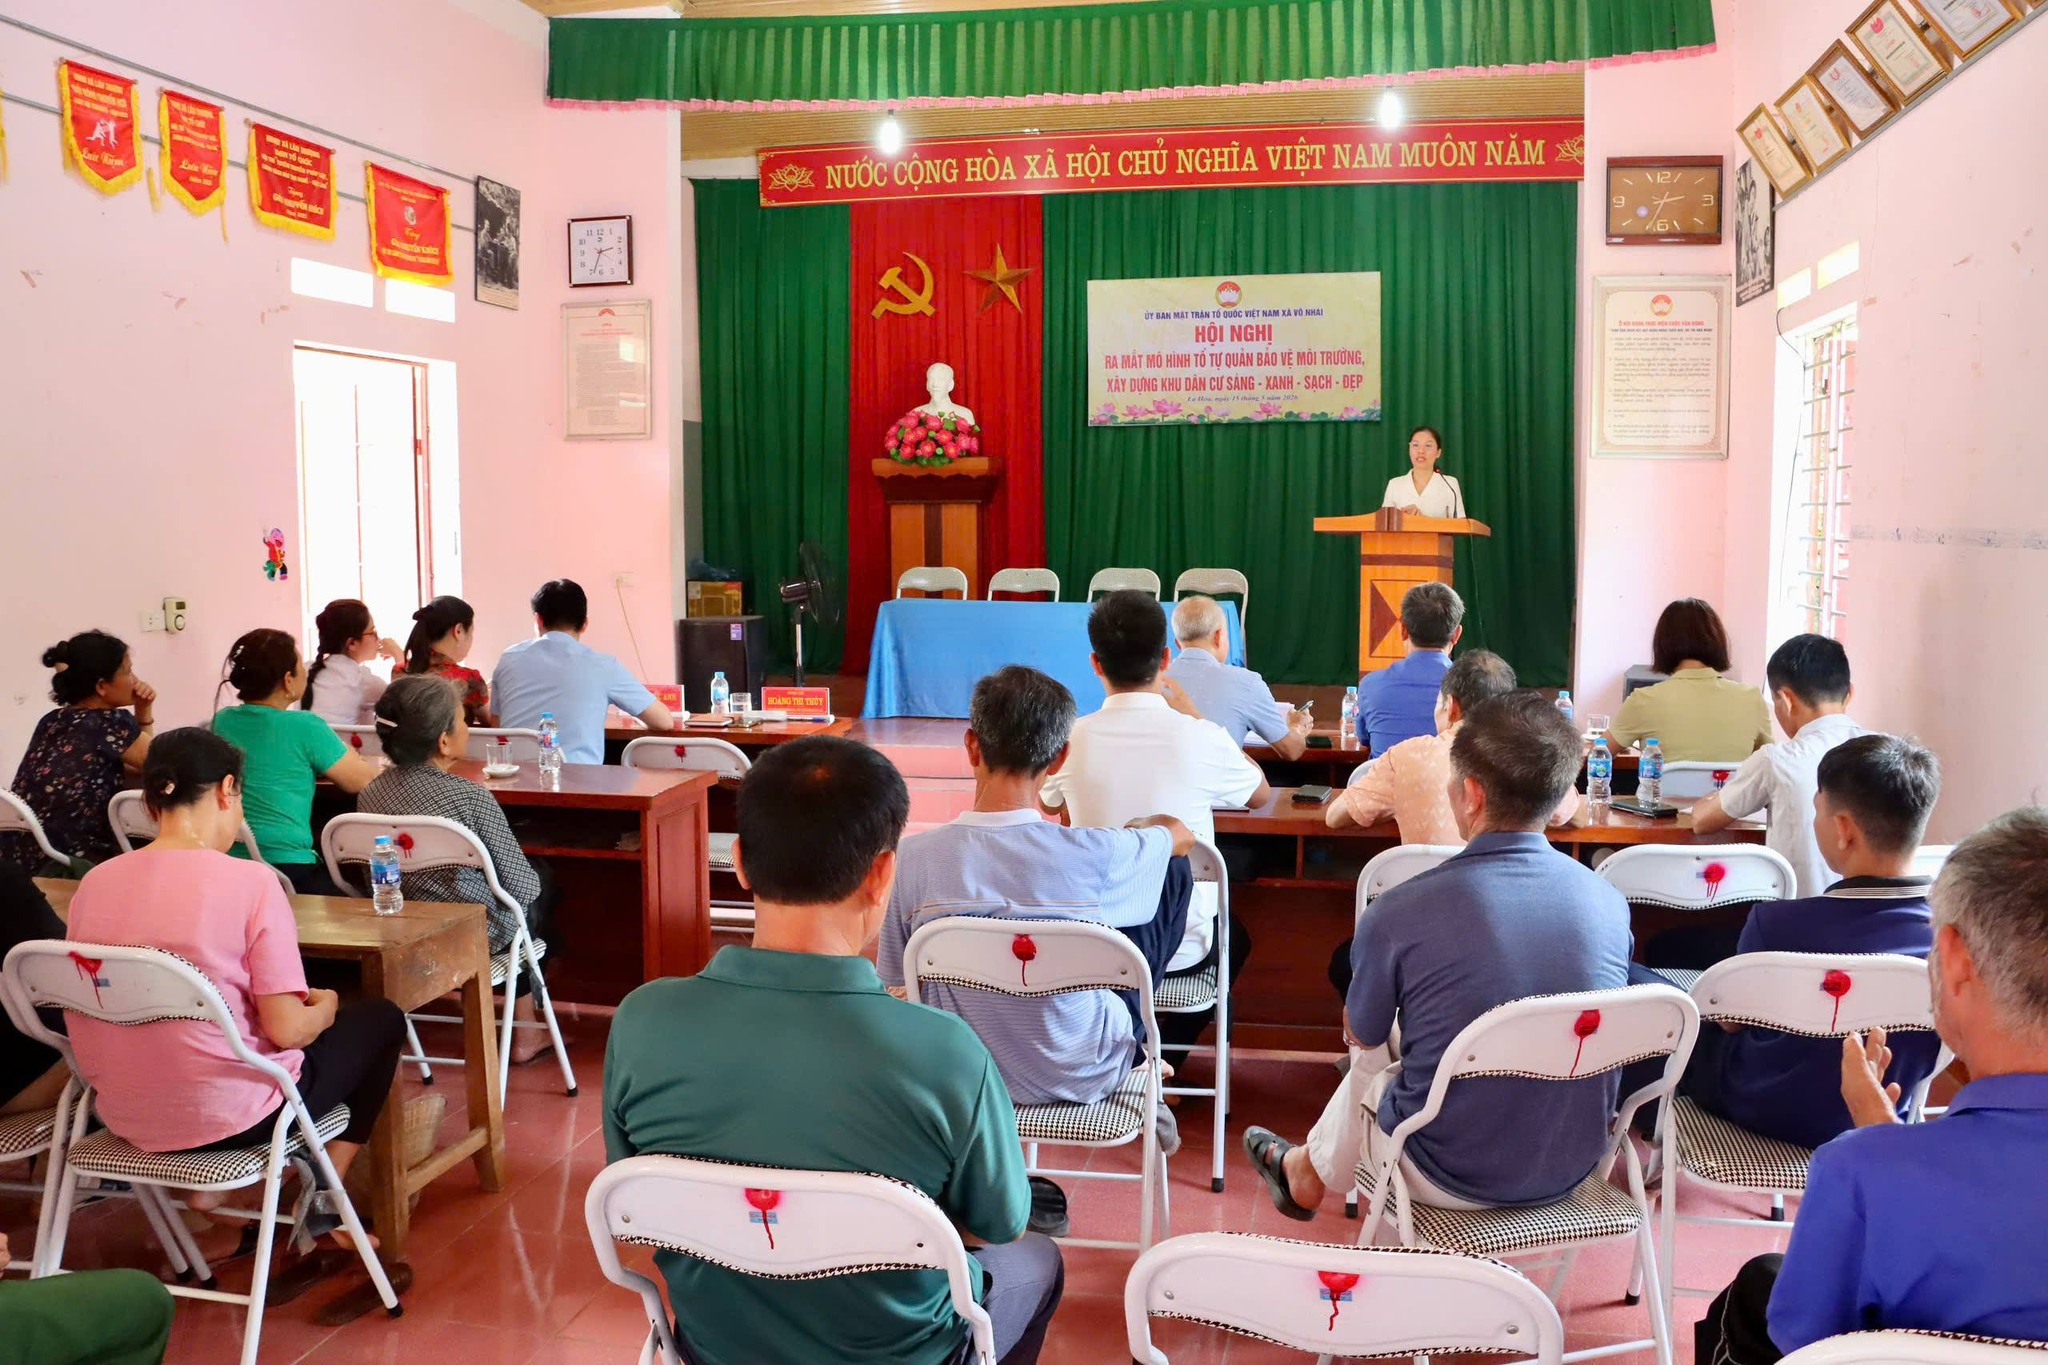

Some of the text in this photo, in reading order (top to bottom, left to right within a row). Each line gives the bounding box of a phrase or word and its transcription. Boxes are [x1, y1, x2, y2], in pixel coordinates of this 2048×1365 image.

[826, 132, 1546, 191] NƯỚC CỘNG HÒA XÃ HỘI CHỦ NGHĨA VIỆT NAM MUÔN NĂM
[1656, 171, 1671, 184] 12
[1612, 195, 1625, 208] 9
[1702, 194, 1714, 207] 3
[1656, 219, 1669, 232] 6
[1155, 312, 1171, 320] BAN
[1222, 308, 1243, 319] QUỐC
[1244, 307, 1260, 319] VIỆT
[1262, 309, 1280, 318] NAM
[1305, 308, 1324, 316] NHAI
[1195, 321, 1273, 346] HỘI NGHỊ
[1105, 355, 1118, 369] RA
[1146, 350, 1163, 368] MÔ
[1165, 350, 1191, 368] HÌNH
[1193, 347, 1206, 368] TỔ
[1209, 352, 1223, 371] TỰ
[1225, 347, 1254, 369] QUẢN
[1256, 347, 1278, 367] BẢO
[1280, 348, 1293, 370] VỆ
[1296, 347, 1317, 366] MÔI
[1320, 347, 1365, 366] TRƯỜNG,
[1107, 375, 1127, 392] XÂY
[1129, 377, 1158, 395] DỰNG
[1161, 377, 1182, 392] KHU
[1184, 374, 1207, 392] DÂN
[1209, 375, 1224, 391] CƯ
[1226, 373, 1255, 391] SÁNG
[1265, 375, 1294, 390] XANH
[1304, 374, 1332, 393] SẠCH
[1342, 374, 1364, 392] ĐẸP
